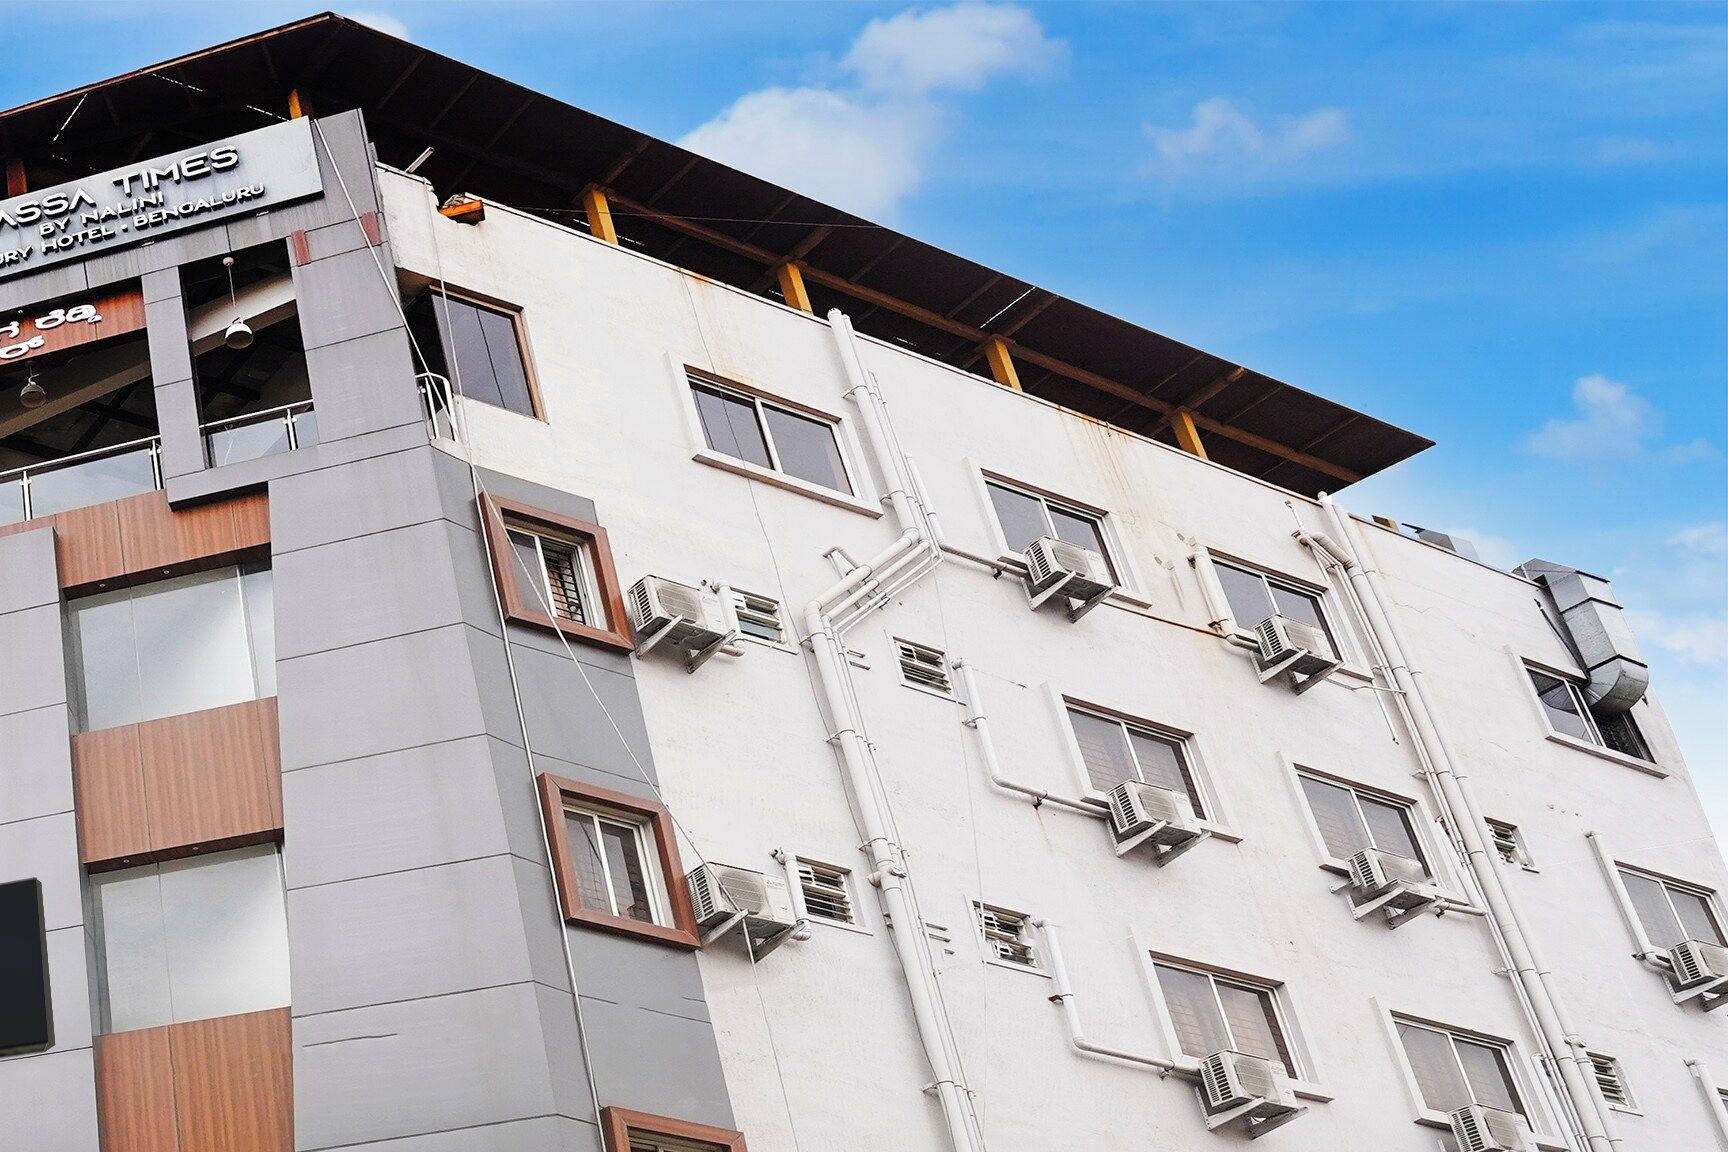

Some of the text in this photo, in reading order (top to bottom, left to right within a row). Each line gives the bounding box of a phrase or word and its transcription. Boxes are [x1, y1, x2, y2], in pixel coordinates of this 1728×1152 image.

[112, 144, 239, 195] TIMES
[39, 192, 165, 238] BY NALINI
[41, 225, 116, 253] HOTEL
[133, 183, 266, 228] BENGALURU
